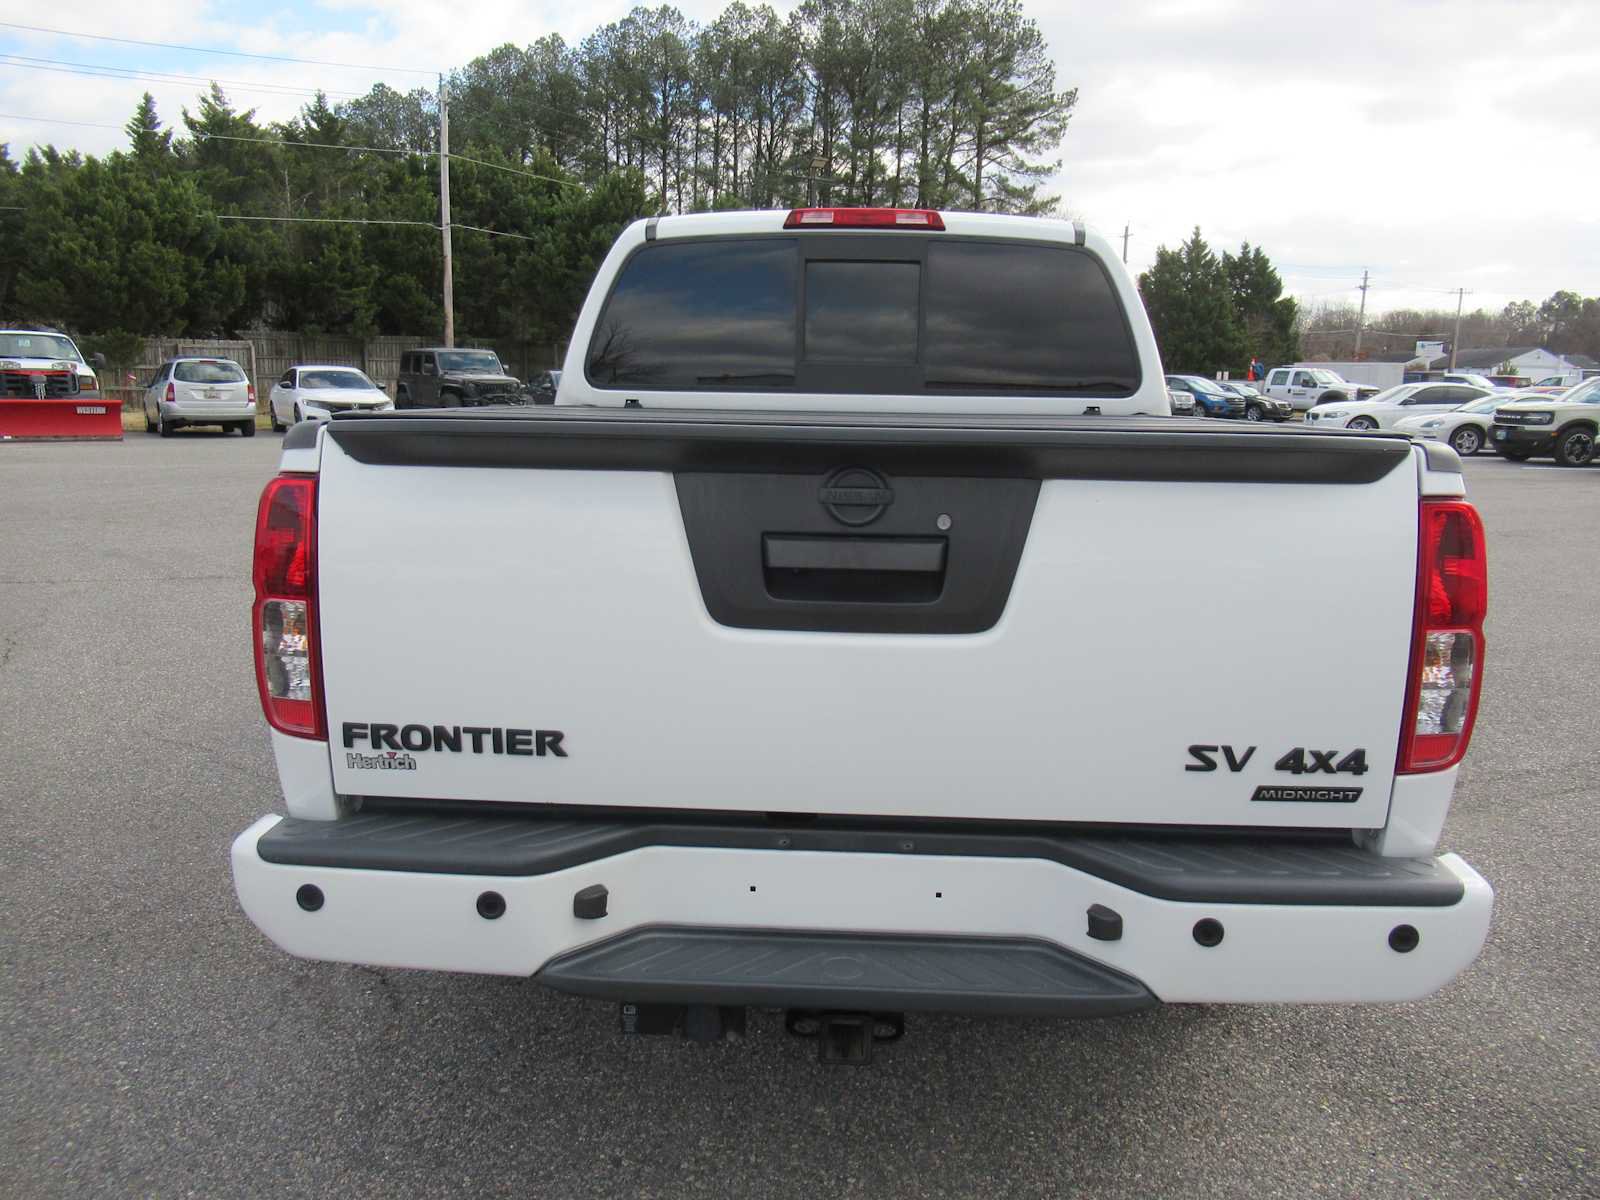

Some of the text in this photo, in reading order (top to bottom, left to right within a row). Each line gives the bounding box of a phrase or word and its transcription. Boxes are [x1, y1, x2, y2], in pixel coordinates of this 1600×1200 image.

[342, 722, 568, 757] FRONTIER
[347, 753, 416, 770] Hertrich
[1185, 744, 1256, 772] SV
[1259, 789, 1358, 801] MIDNIGHT
